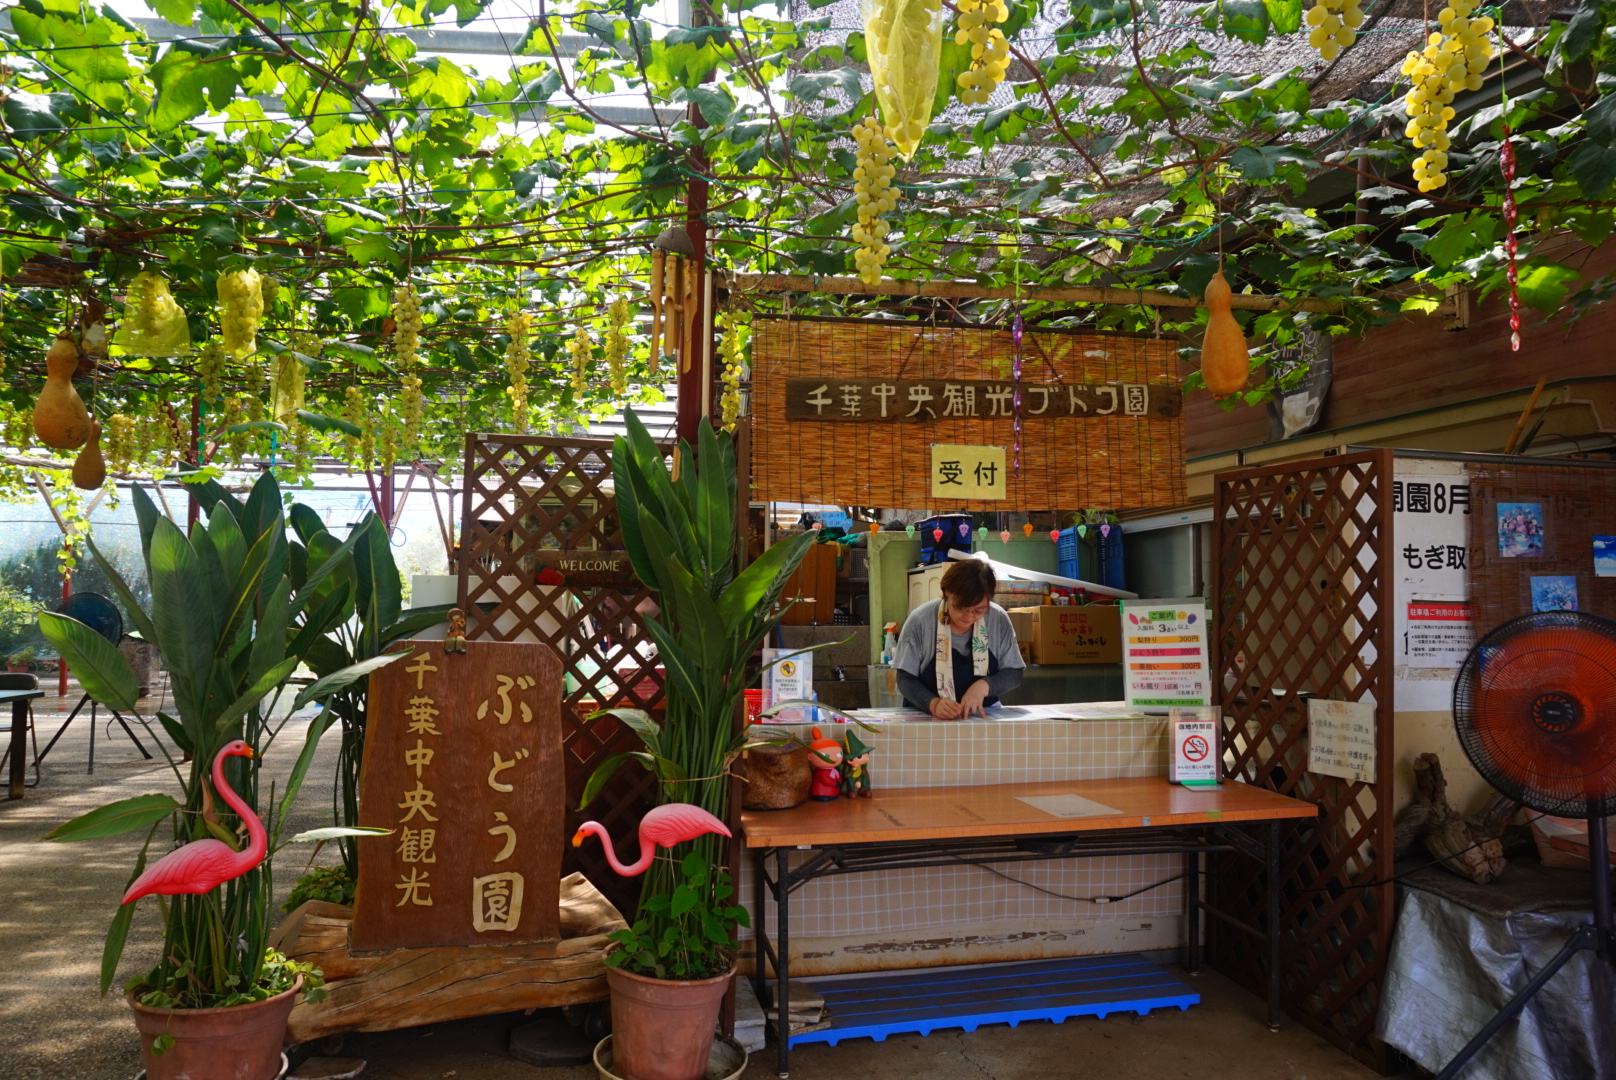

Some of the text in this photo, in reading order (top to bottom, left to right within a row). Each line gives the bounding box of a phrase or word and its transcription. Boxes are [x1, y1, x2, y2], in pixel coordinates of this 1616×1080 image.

[938, 460, 998, 487] 受付
[560, 560, 620, 571] WELCOME
[1151, 611, 1174, 620] ご案内
[1180, 647, 1200, 655] 300円
[1180, 662, 1201, 670] 300円
[395, 651, 443, 908] 千葉中央観光
[473, 674, 536, 933] ぶどう園
